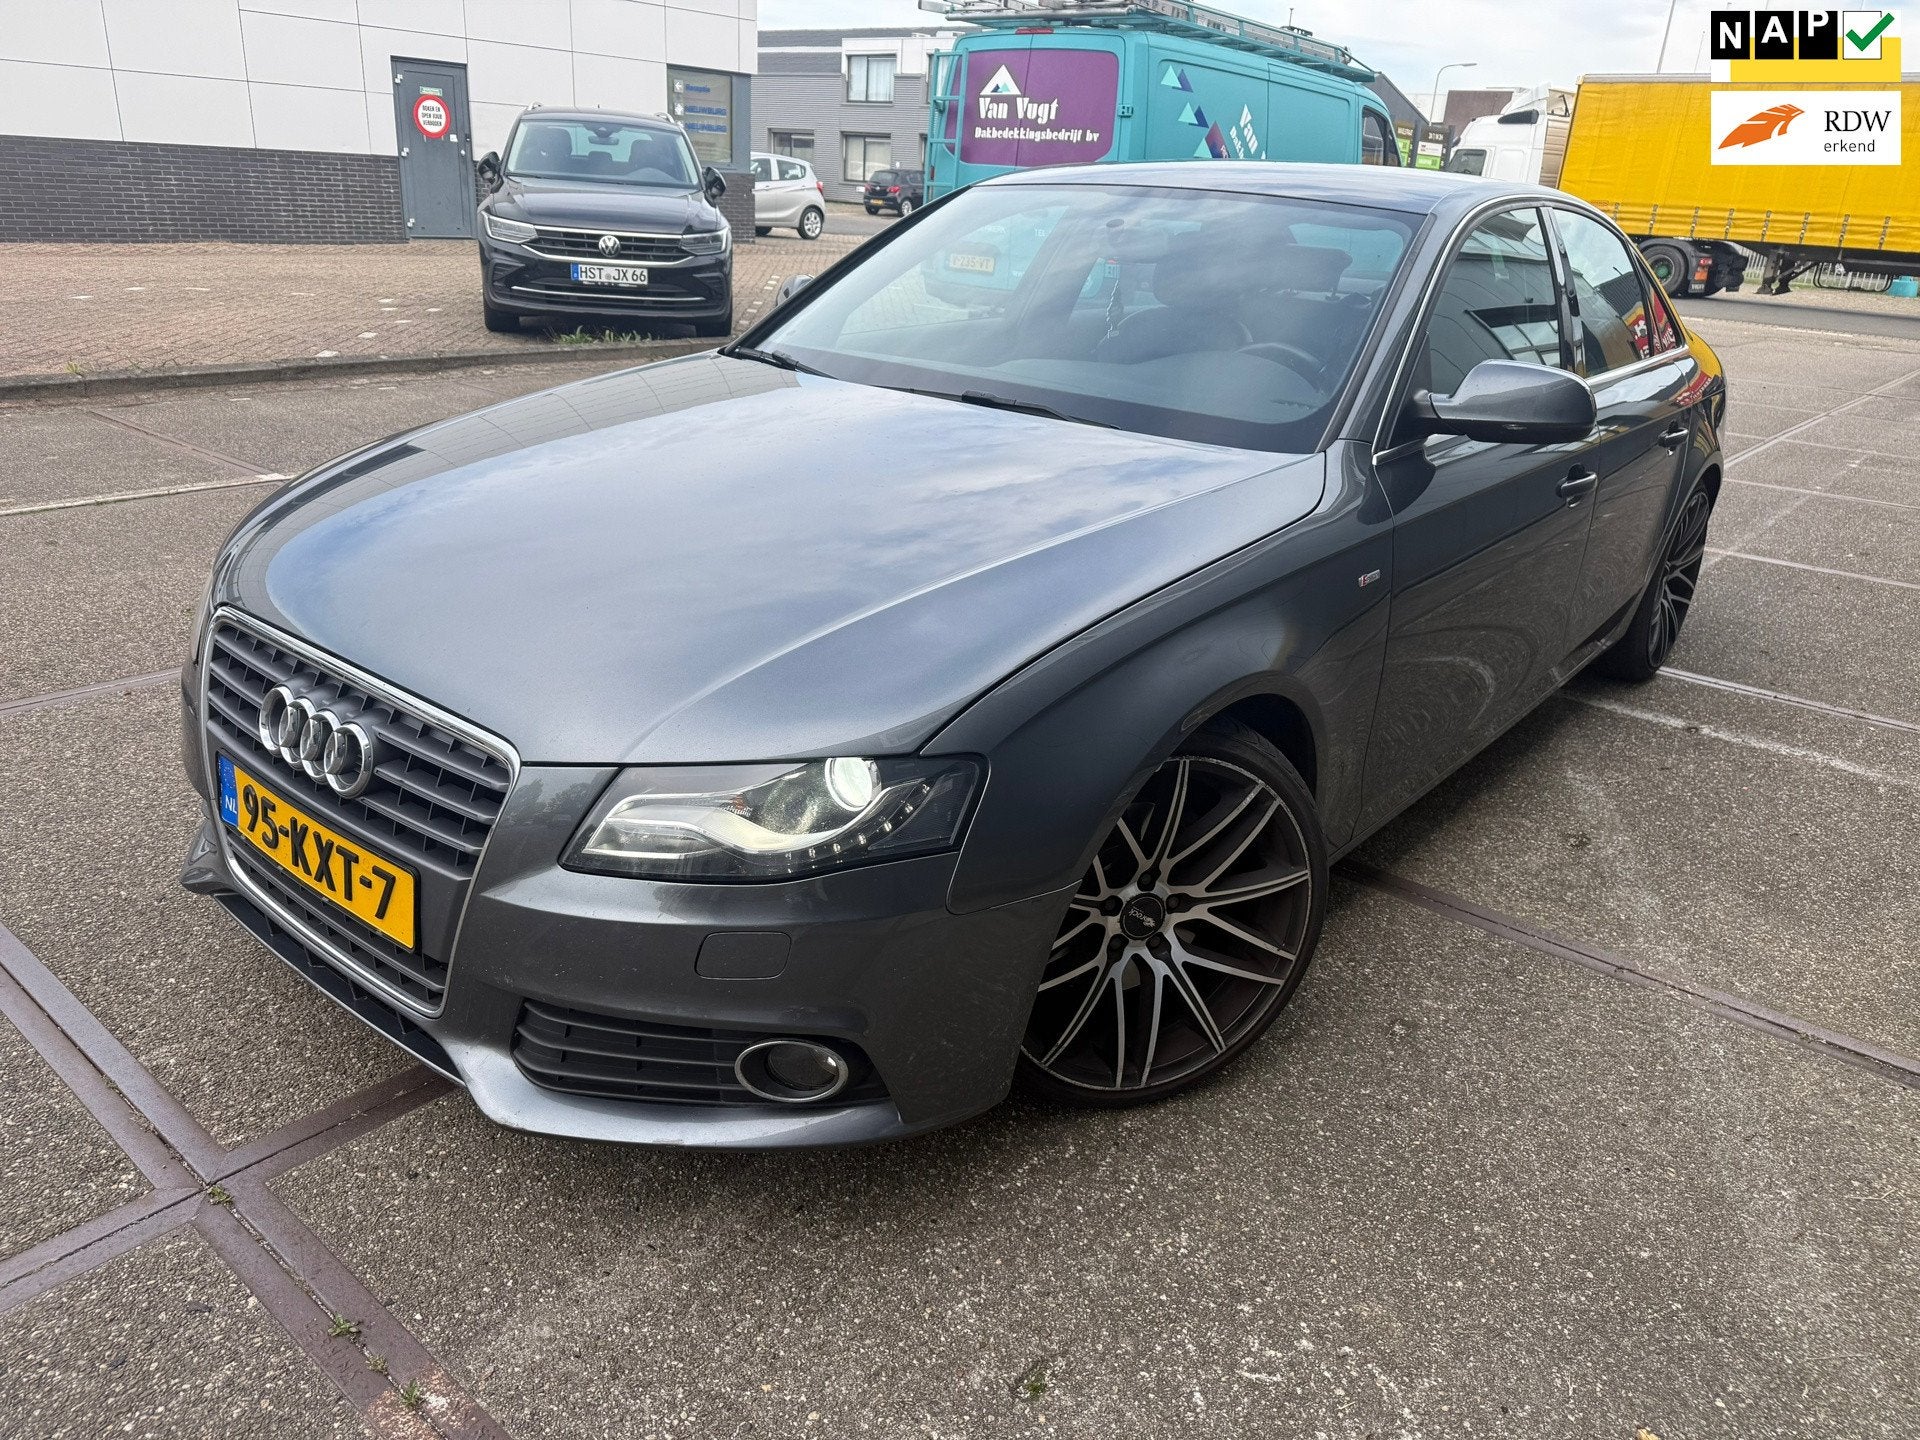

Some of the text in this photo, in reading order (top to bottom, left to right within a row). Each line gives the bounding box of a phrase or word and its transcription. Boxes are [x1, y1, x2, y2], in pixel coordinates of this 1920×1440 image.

[978, 97, 1059, 124] Van Vugt
[974, 126, 1100, 144] Dakbedekkingsbedrijf bv
[580, 266, 604, 279] HST
[612, 268, 629, 281] JX
[631, 270, 647, 282] 66
[225, 795, 238, 815] NL
[242, 783, 396, 921] 95-KXT-7
